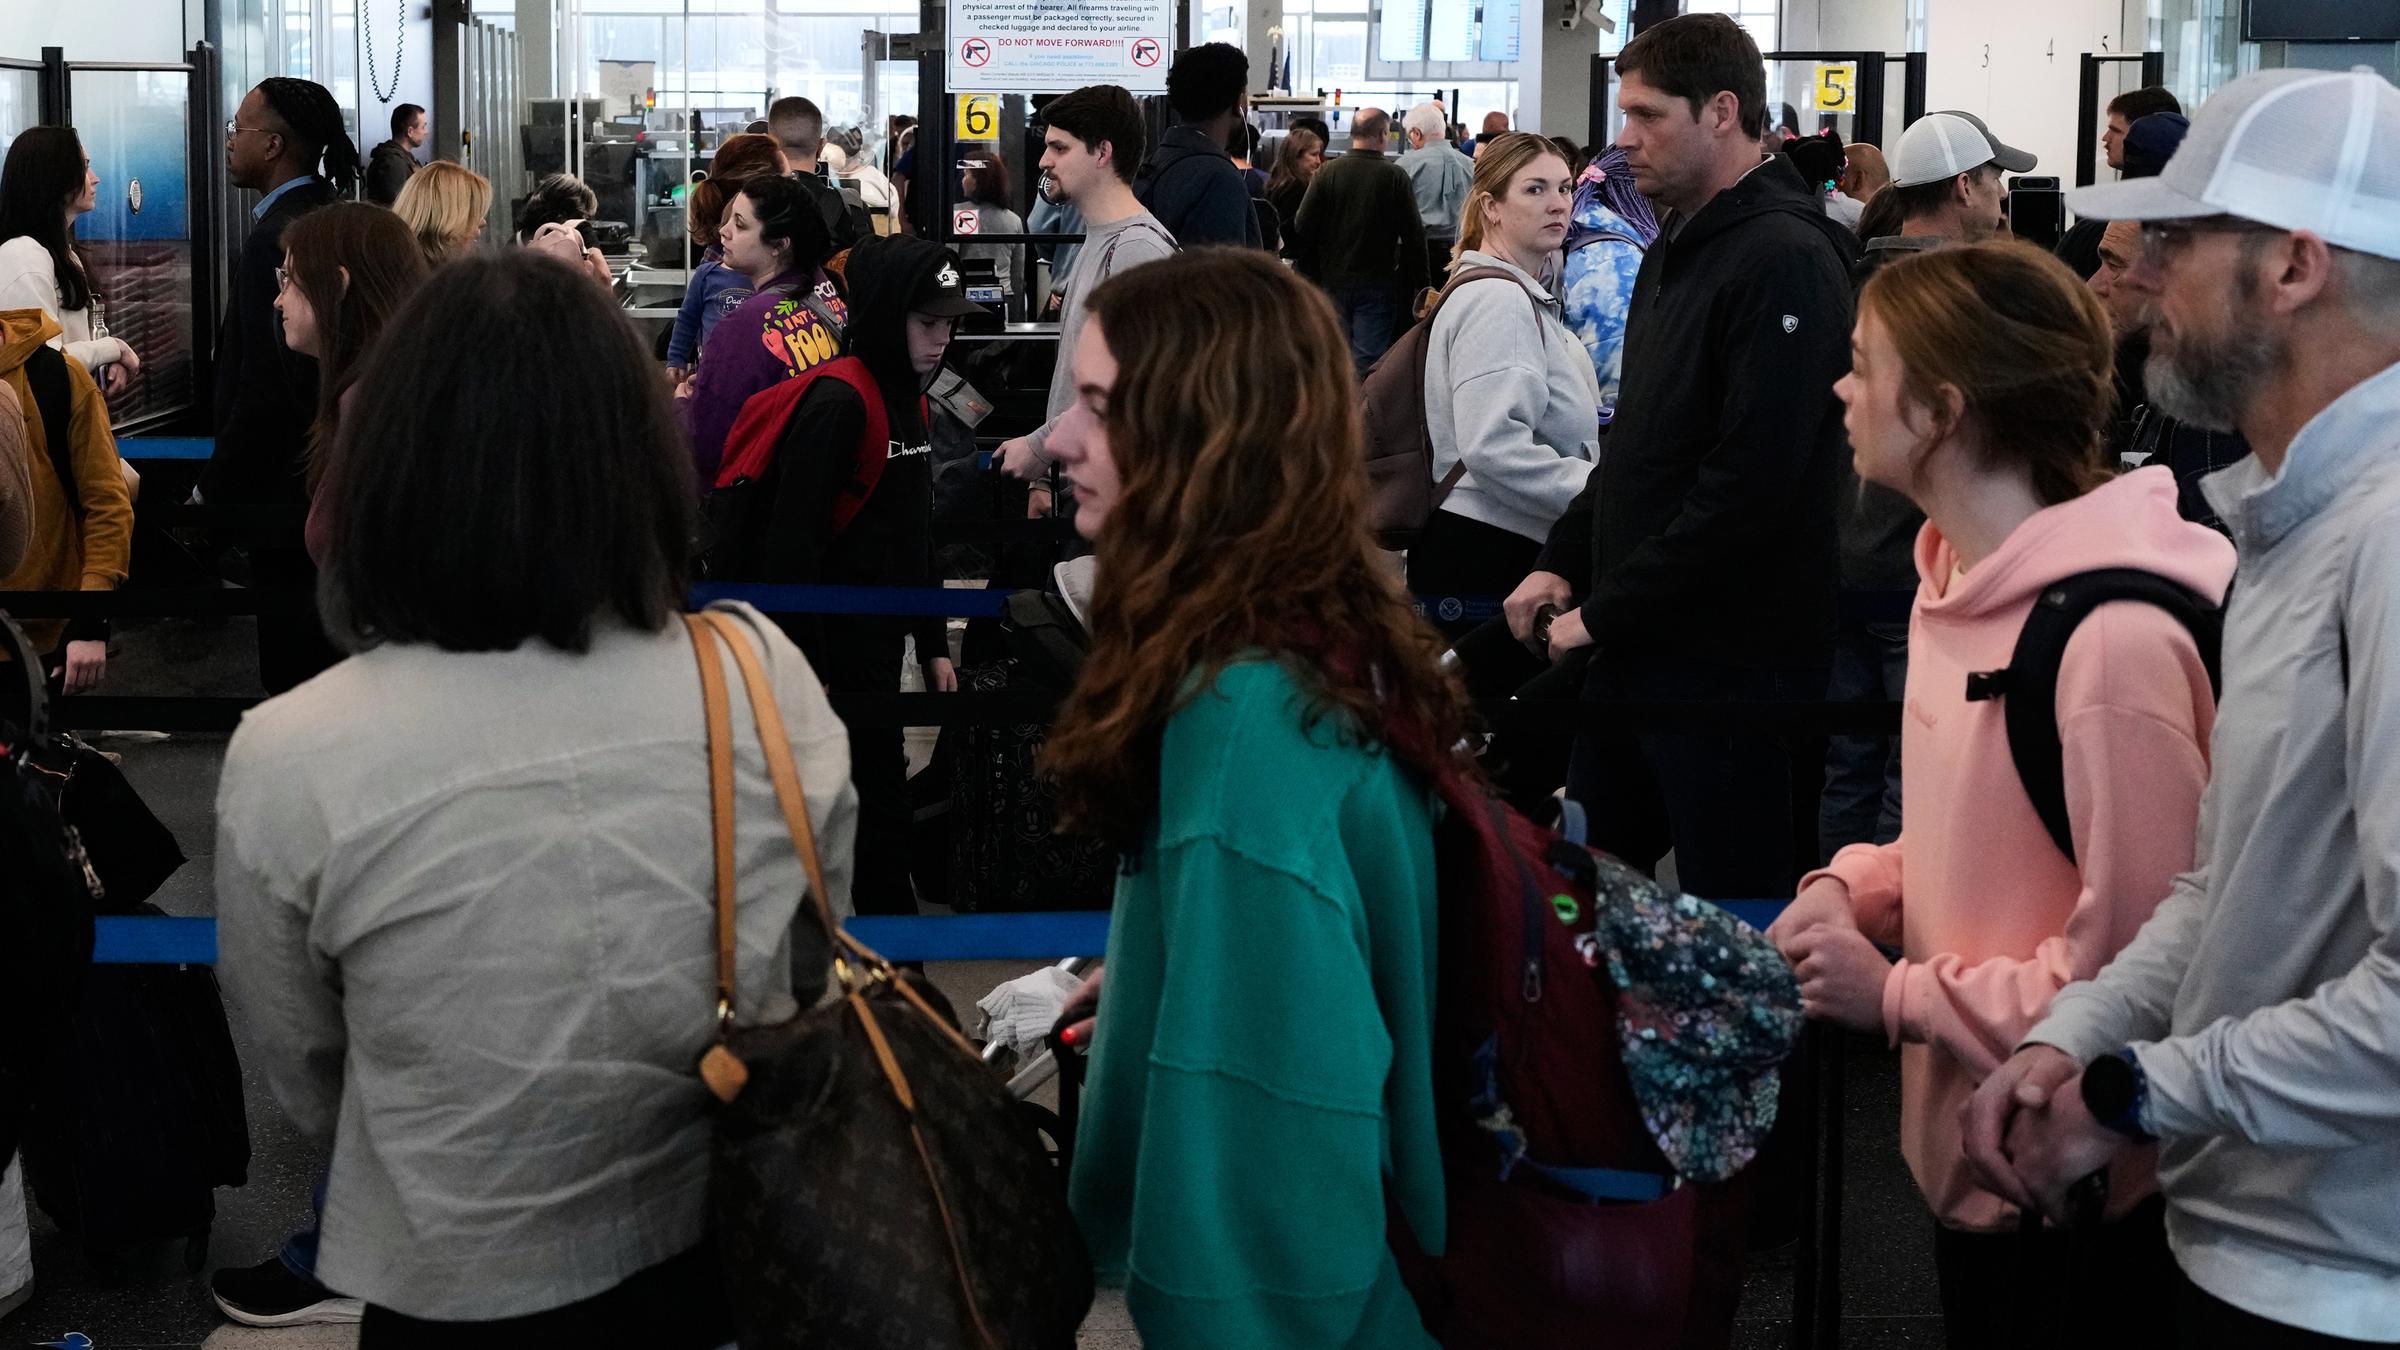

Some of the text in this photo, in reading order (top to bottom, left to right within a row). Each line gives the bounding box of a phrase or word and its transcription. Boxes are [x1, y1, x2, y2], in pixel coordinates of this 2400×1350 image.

[1036, 39, 1063, 47] MOVE
[1065, 39, 1124, 47] FORWARD!!!!
[1981, 44, 1990, 68] 3
[2046, 38, 2054, 64] 4
[1823, 69, 1846, 106] 5
[965, 97, 991, 135] 6
[1031, 124, 1045, 138] TS
